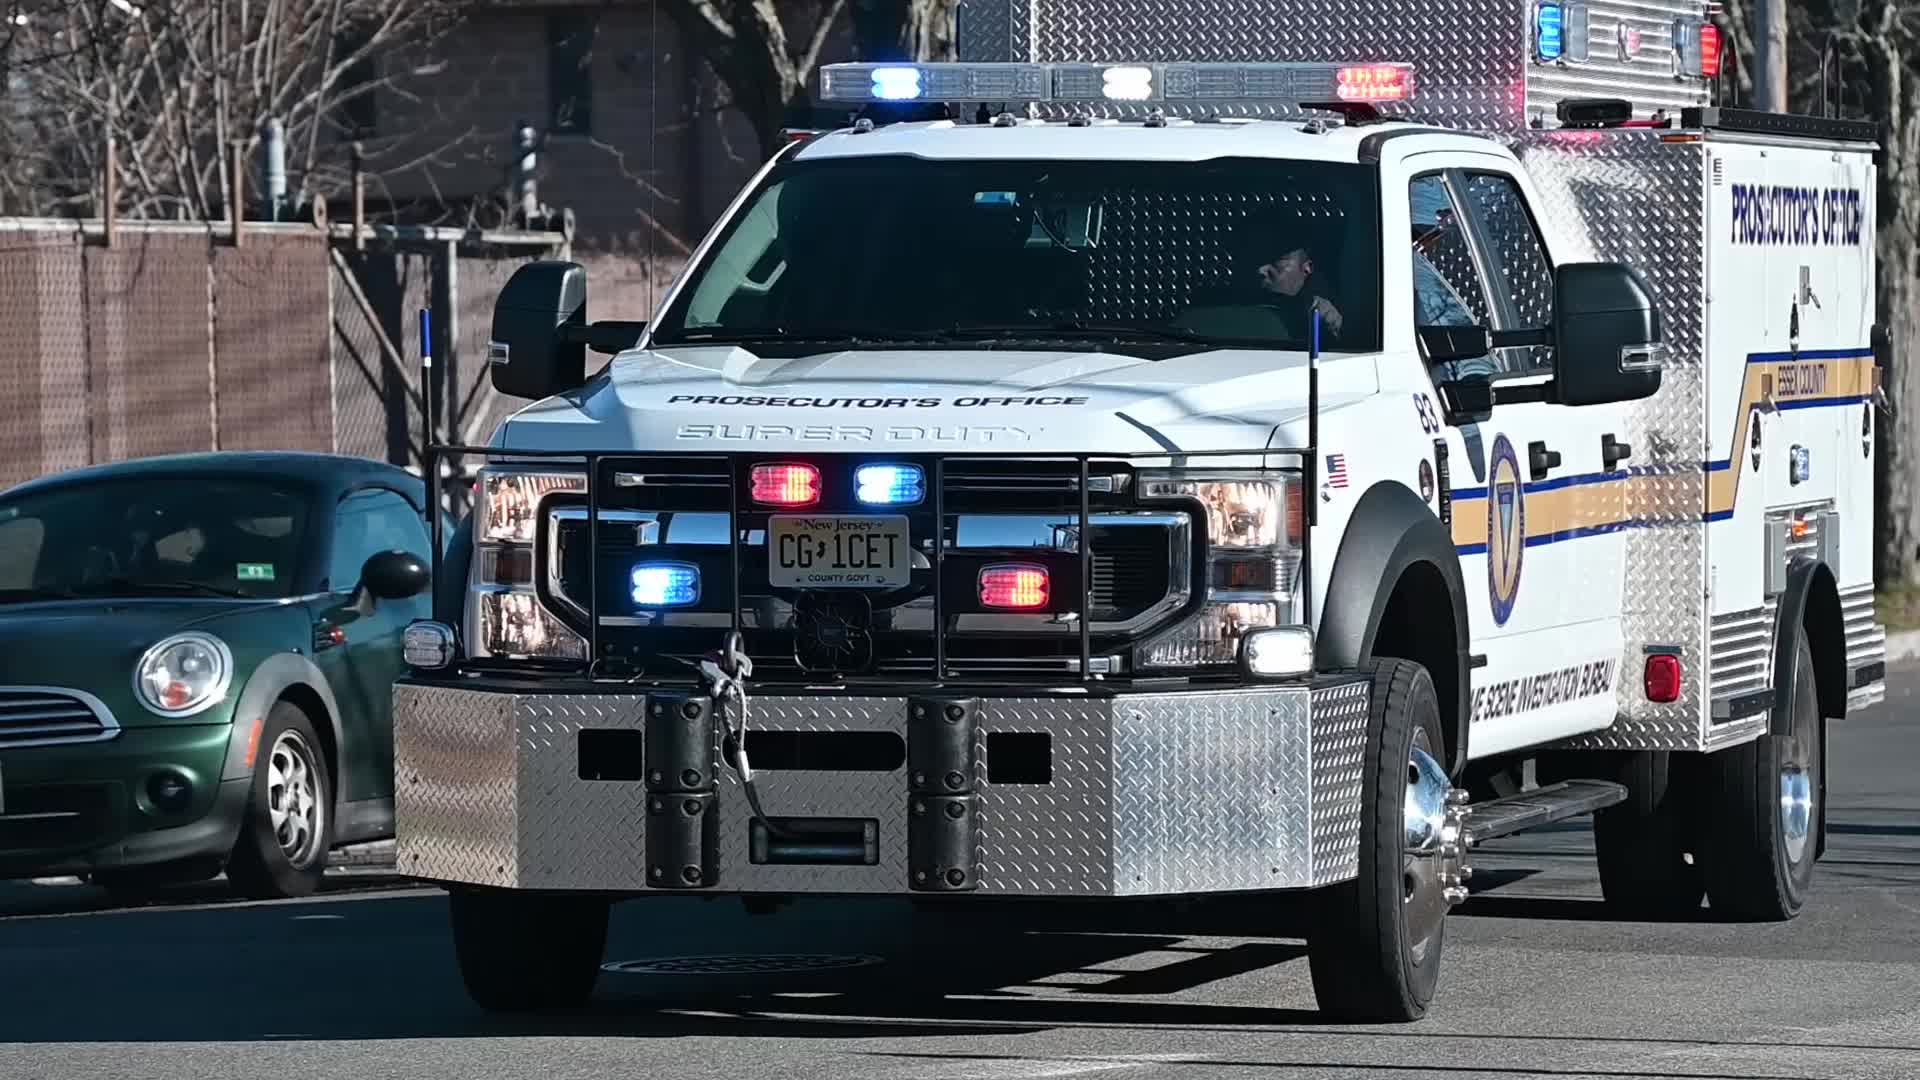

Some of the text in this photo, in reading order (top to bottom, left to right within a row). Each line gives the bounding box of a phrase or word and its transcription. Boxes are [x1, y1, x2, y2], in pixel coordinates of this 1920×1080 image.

[1731, 184, 1860, 246] PROSECUTOR'S OFFICE
[668, 395, 1088, 408] PROSECUTOR'S OFFICE
[1412, 393, 1440, 434] 83
[675, 424, 1044, 441] SUPER DUTY
[804, 519, 874, 532] New Jersey
[808, 574, 870, 582] COUNTY GOVT
[1483, 679, 1519, 720] SCENE
[1516, 664, 1582, 714] INVESTIGATION
[1578, 658, 1616, 699] BUREAU
